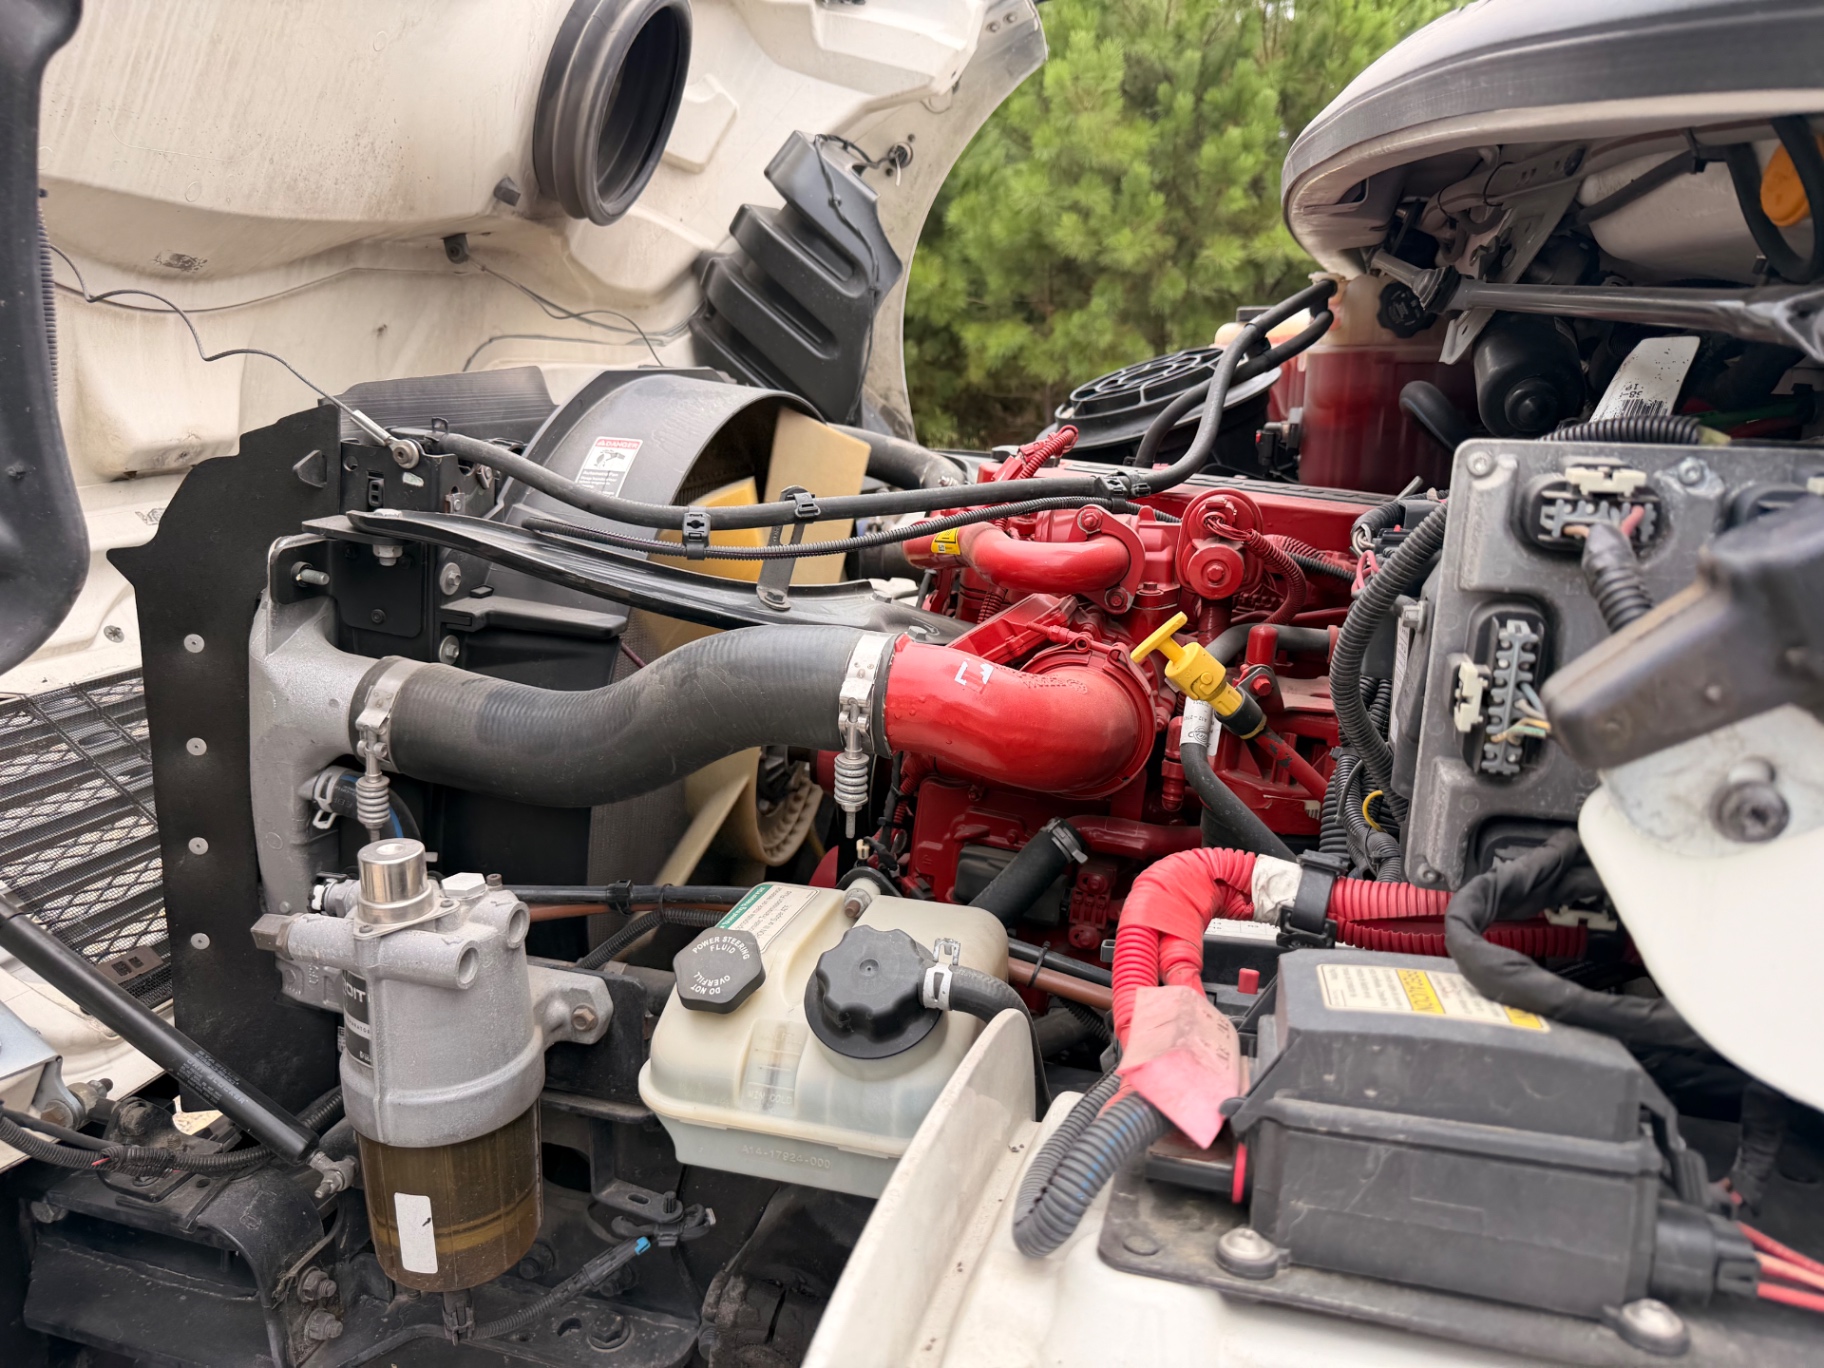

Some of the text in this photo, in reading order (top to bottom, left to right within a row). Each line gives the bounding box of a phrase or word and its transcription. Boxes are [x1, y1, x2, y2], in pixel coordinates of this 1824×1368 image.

[605, 441, 639, 449] DANGER
[692, 936, 750, 960] POWER STEERING
[709, 944, 736, 954] FLUID
[693, 971, 731, 987] OVERFILL
[690, 983, 721, 995] DO NOT
